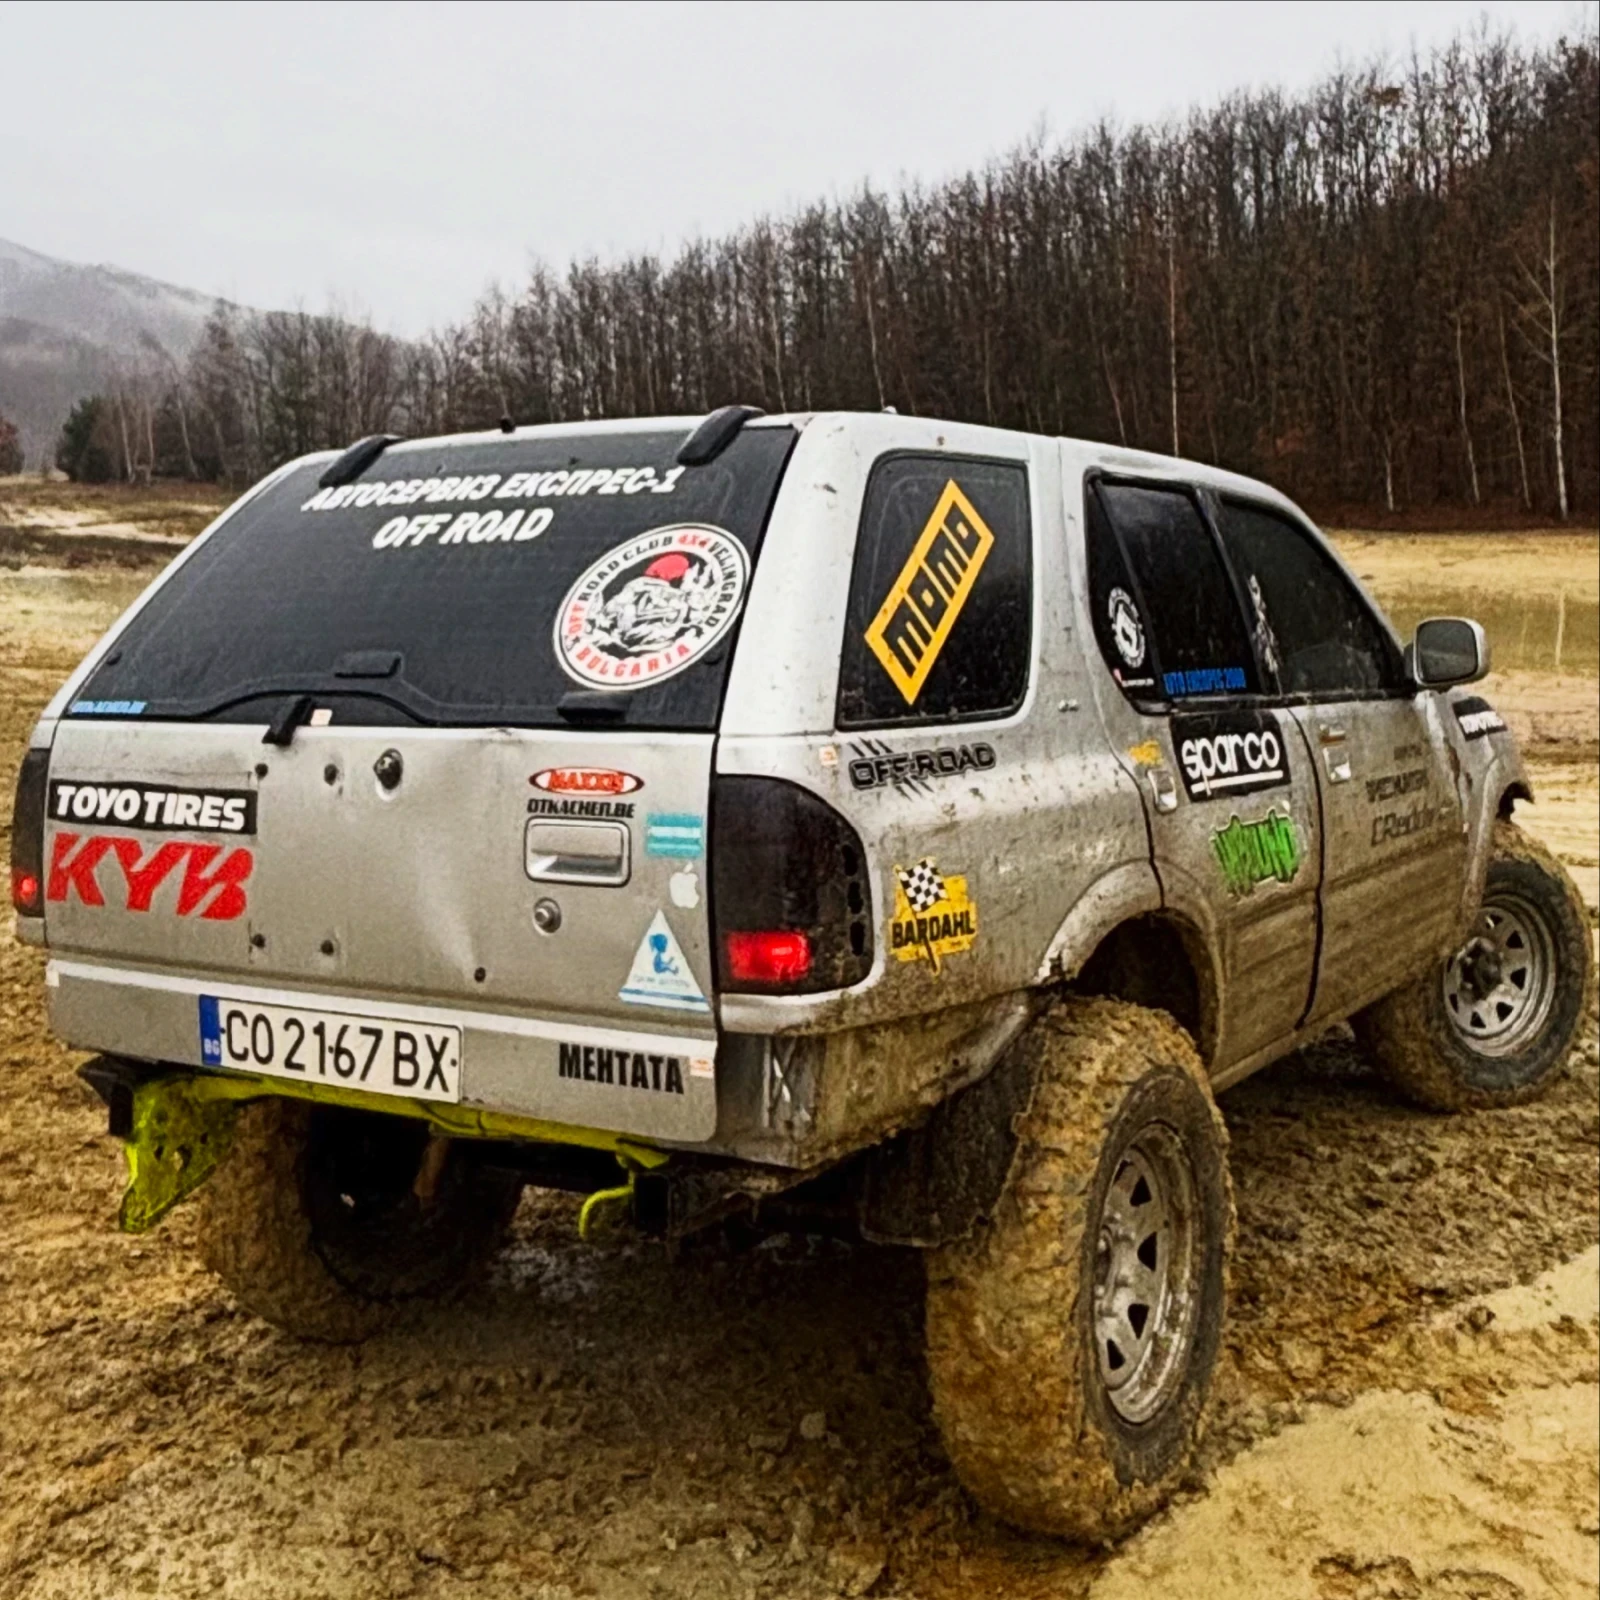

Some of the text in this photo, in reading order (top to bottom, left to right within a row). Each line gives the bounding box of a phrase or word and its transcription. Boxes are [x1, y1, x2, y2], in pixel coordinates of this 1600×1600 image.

[301, 465, 686, 512] АВТОСЕРВИЗ ЕКСПРЕС-1
[372, 507, 554, 549] OFF ROAD
[568, 604, 585, 637] OFF
[578, 560, 621, 602] ROAD
[623, 535, 674, 562] CLUB
[704, 541, 738, 628] VELINGRAD
[575, 643, 691, 678] BULGARIA
[1181, 731, 1280, 796] sparco
[56, 785, 247, 831] TOYO TIRES
[47, 832, 254, 921] KYB
[891, 909, 976, 949] BARDAHL
[203, 1038, 221, 1056] BG
